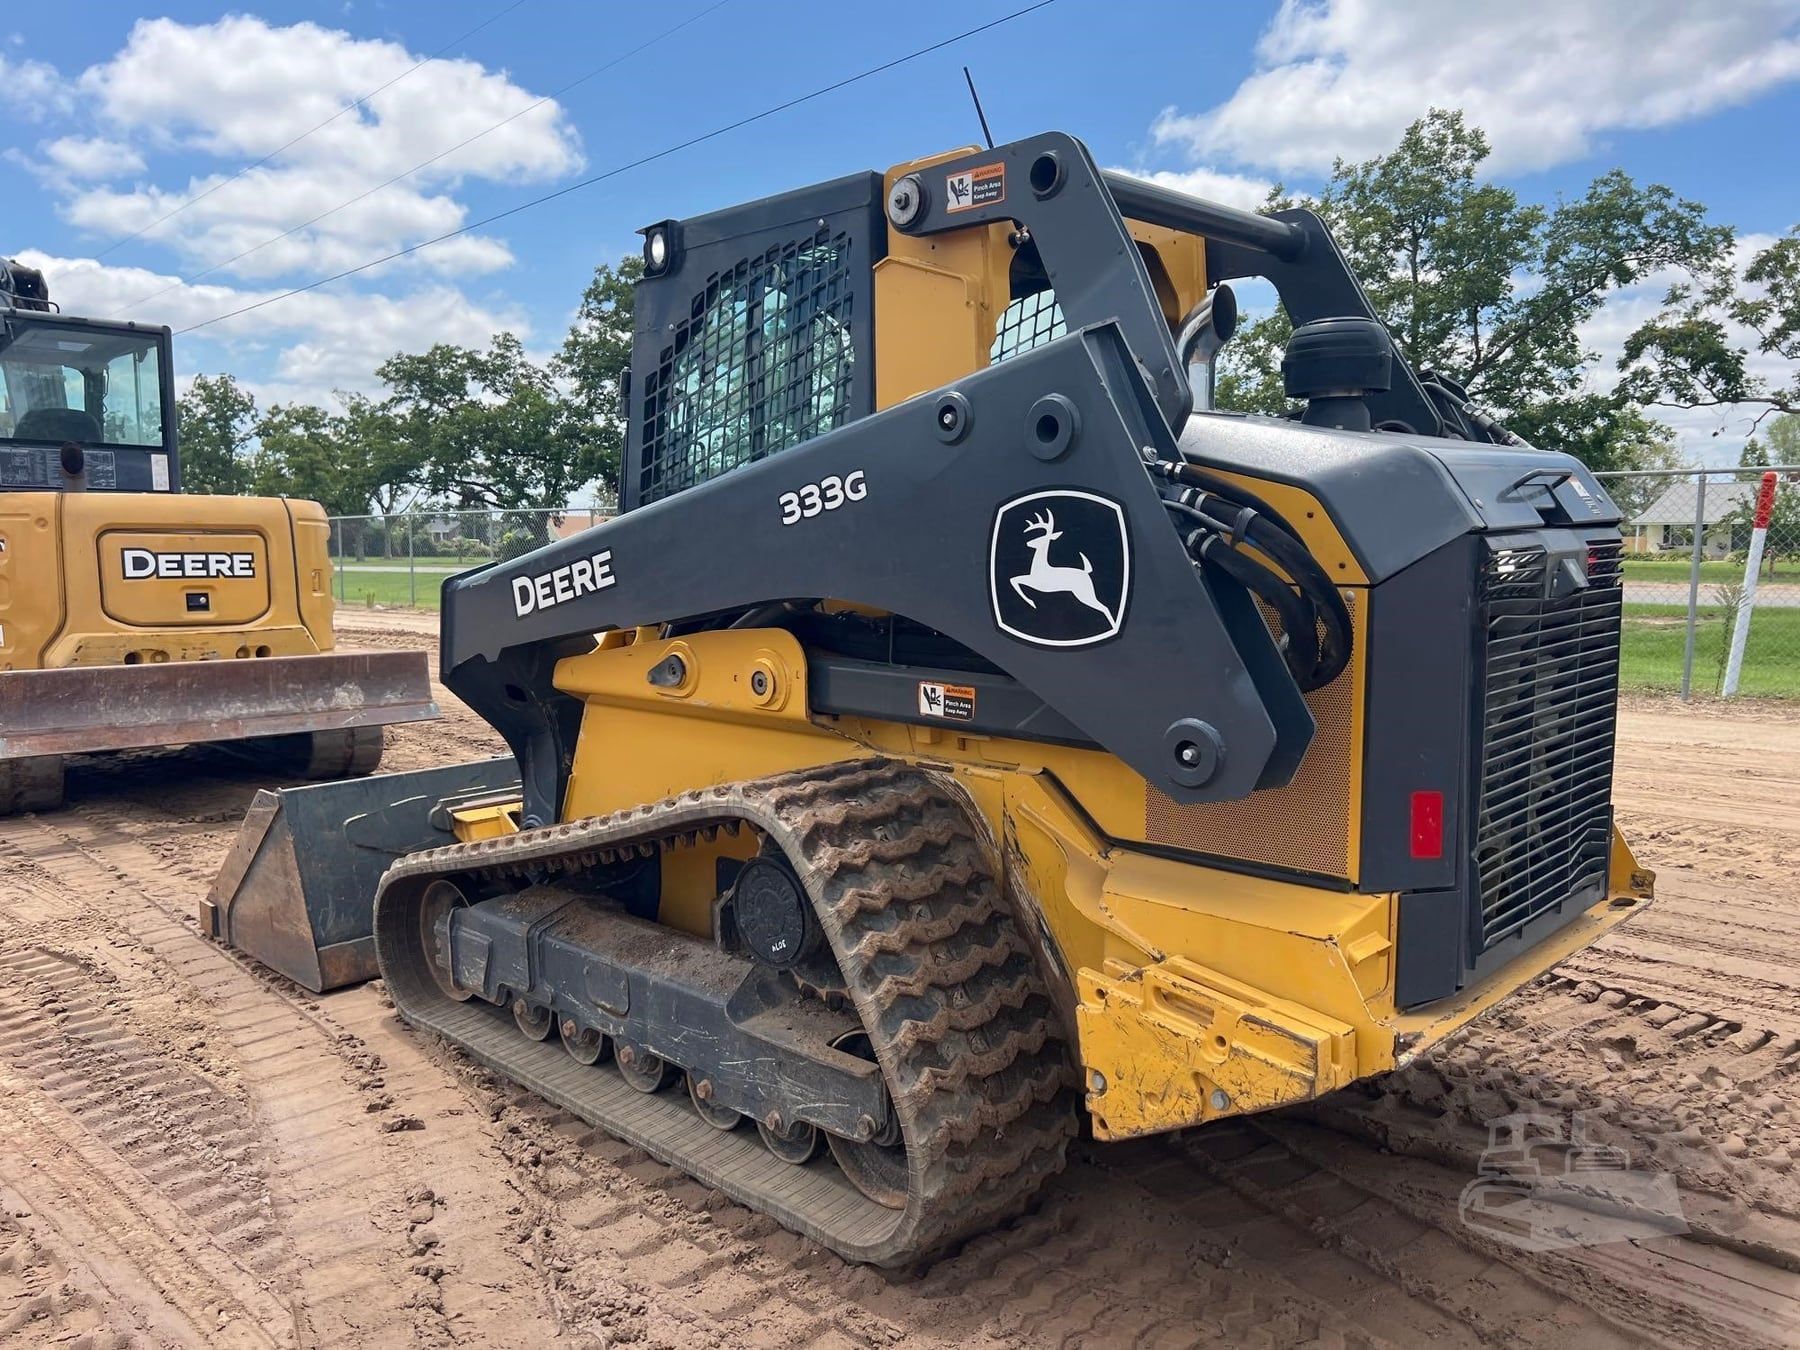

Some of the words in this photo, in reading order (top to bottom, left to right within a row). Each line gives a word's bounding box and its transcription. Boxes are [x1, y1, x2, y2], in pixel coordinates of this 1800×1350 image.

[974, 184, 988, 192] Pinch
[989, 181, 1001, 189] Area
[779, 470, 868, 525] 333G
[123, 549, 254, 578] DEERE
[511, 550, 616, 617] DEERE
[945, 699, 959, 707] Pinch
[960, 701, 971, 709] Area
